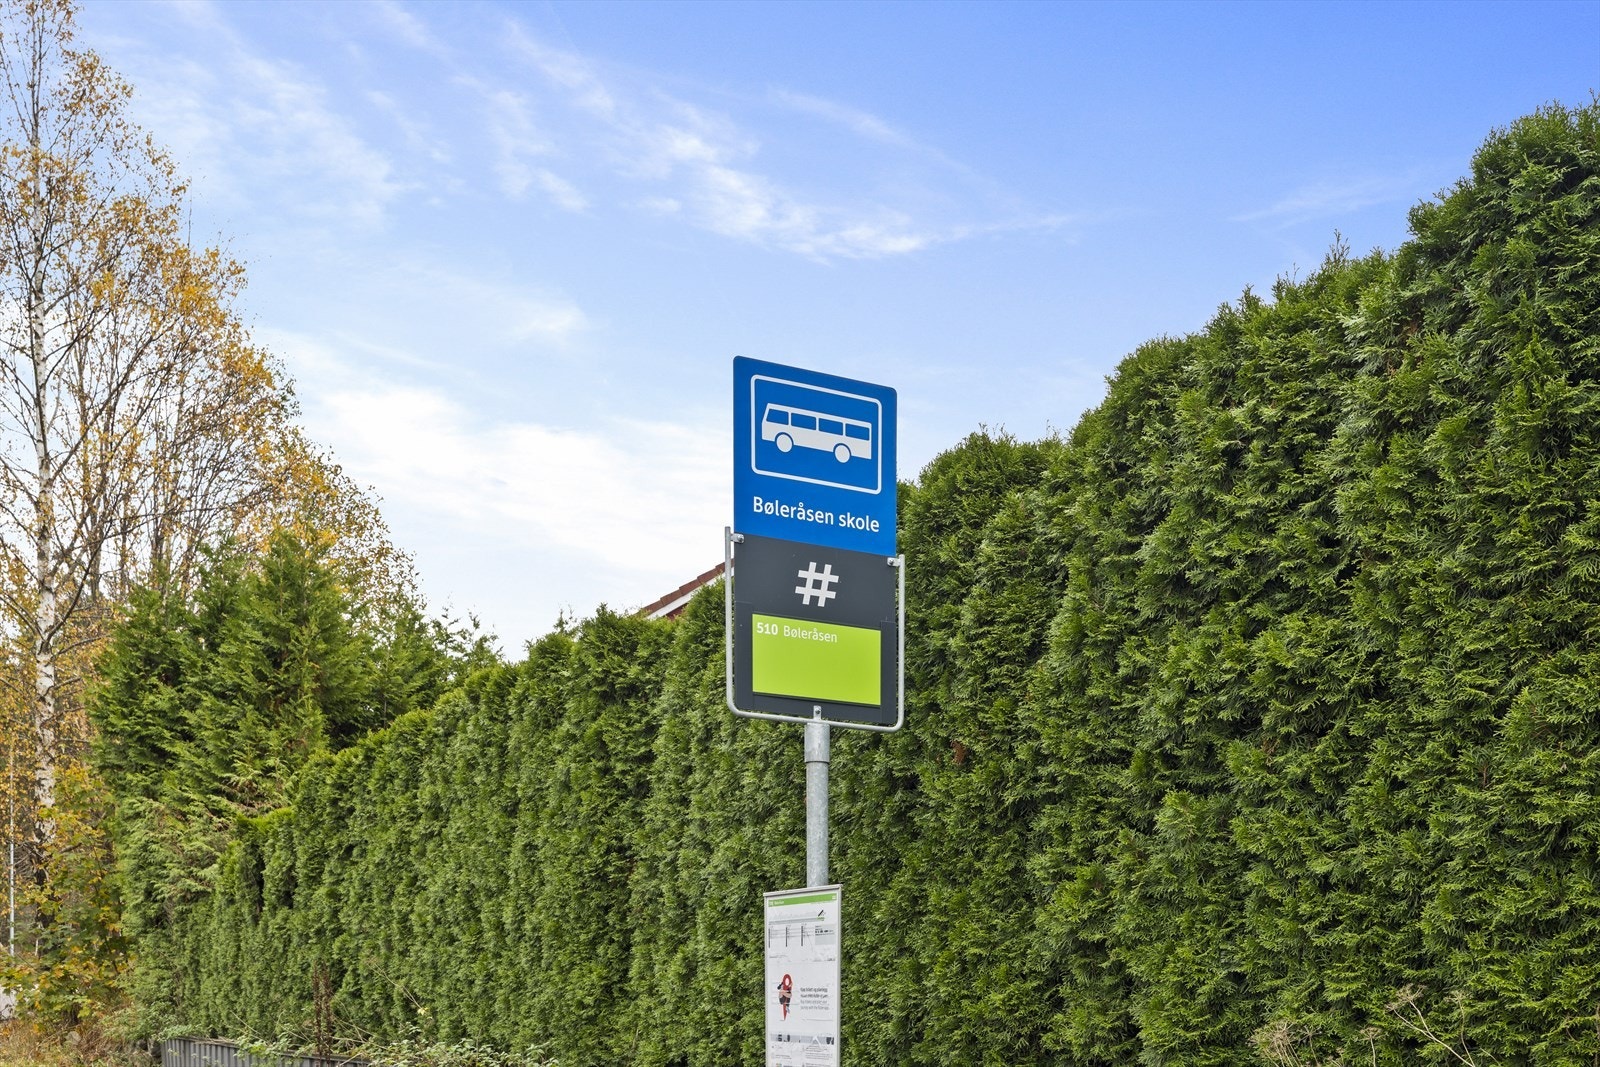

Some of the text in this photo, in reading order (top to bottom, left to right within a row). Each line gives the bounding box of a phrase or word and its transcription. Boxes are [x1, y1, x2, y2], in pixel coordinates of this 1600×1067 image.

[753, 496, 880, 533] Bøleråsen skole
[756, 622, 838, 643] 510 Bøleråsen
